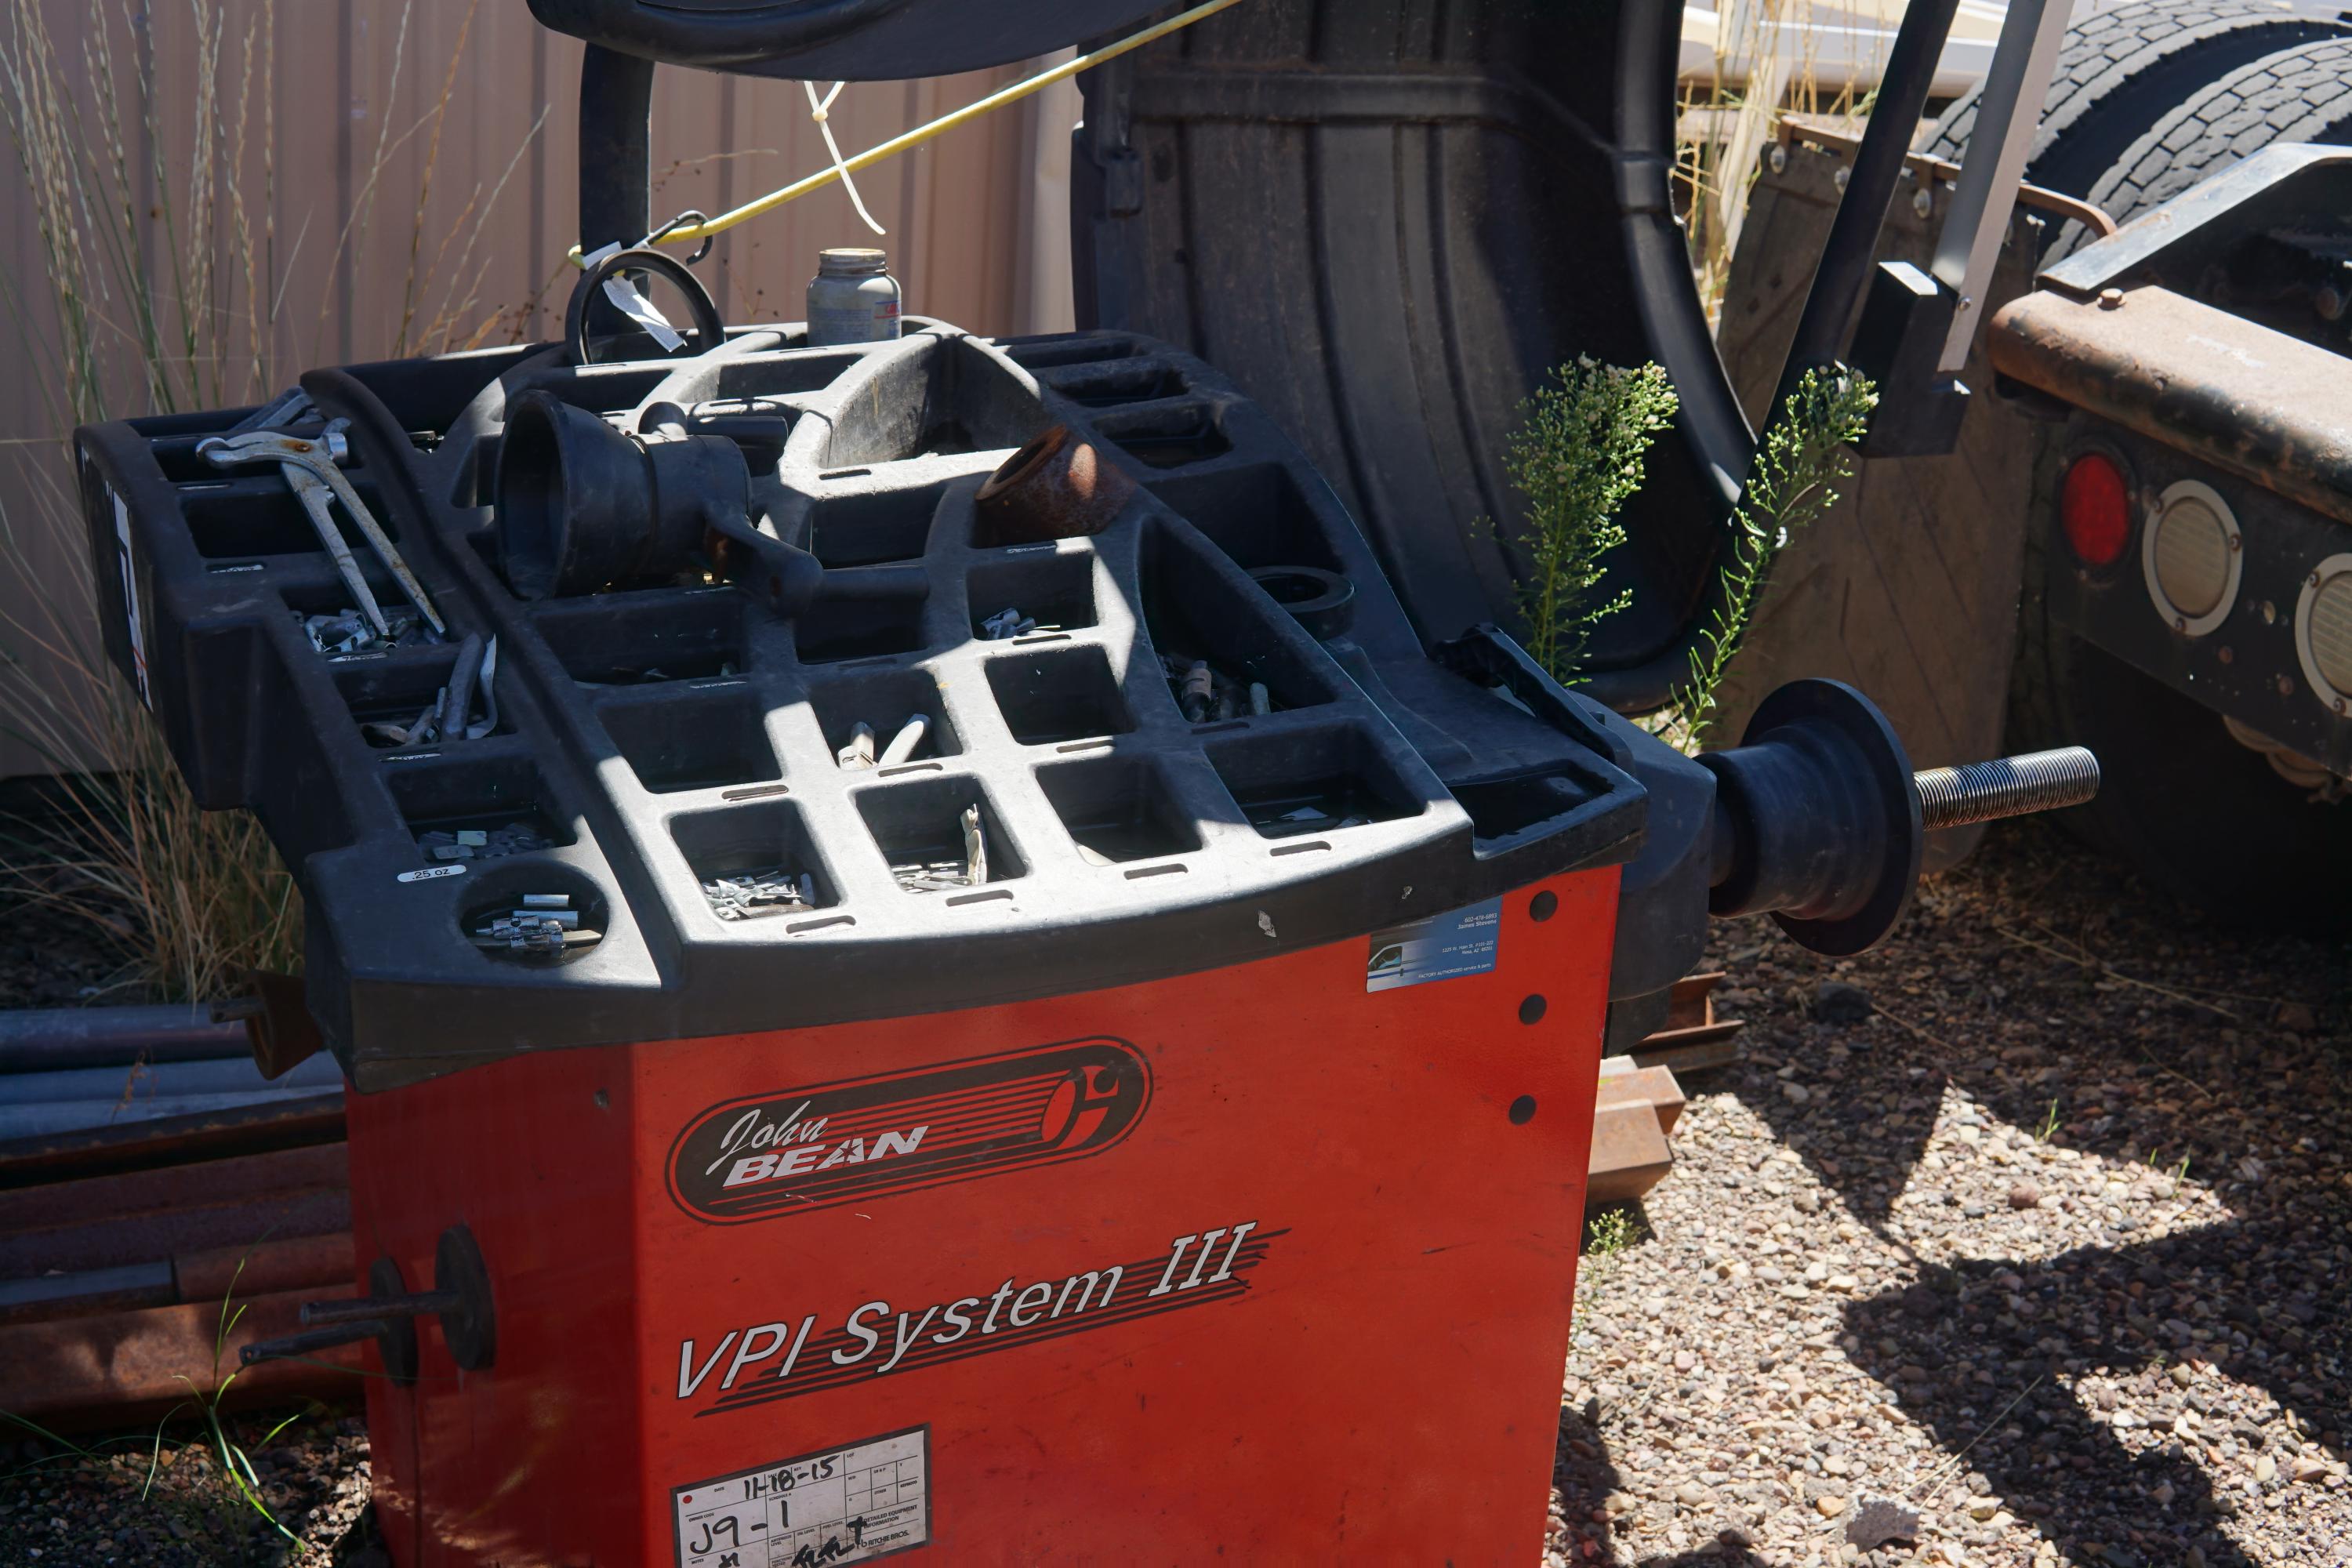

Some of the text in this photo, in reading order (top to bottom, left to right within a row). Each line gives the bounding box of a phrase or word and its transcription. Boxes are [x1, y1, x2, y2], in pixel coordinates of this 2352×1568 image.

[412, 871, 430, 880] .25
[706, 1100, 828, 1175] John
[722, 1125, 929, 1188] BEAN
[677, 1221, 1256, 1399] VPI System III
[744, 1455, 840, 1500] 11-18-15
[769, 1494, 788, 1502] SCHEDULE
[864, 1504, 917, 1523] DETAILED EQUIPMENT
[864, 1515, 899, 1529] INFORMATION
[868, 1534, 891, 1546] RITCHIE
[891, 1530, 909, 1539] BROS.
